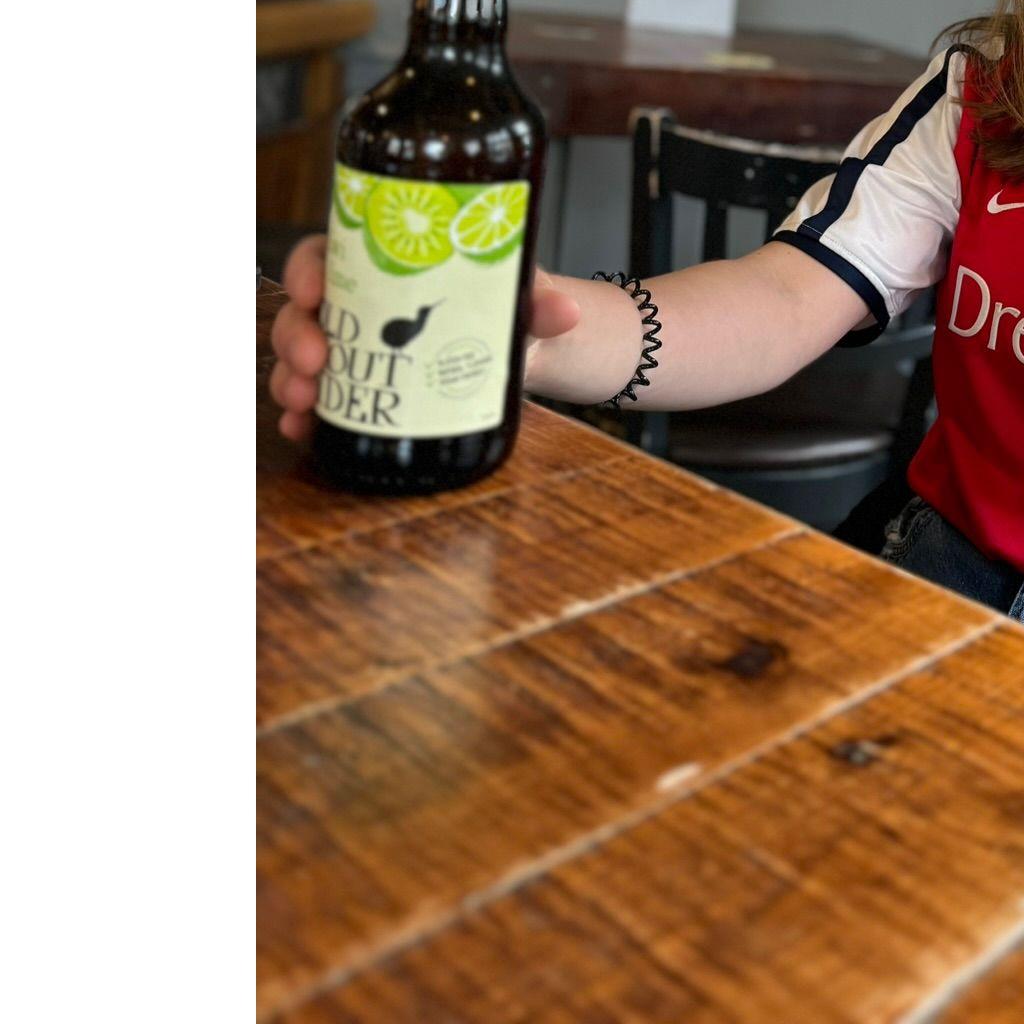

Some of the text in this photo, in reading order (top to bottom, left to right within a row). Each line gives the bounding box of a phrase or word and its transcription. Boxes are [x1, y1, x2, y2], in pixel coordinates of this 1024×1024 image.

[321, 302, 360, 343] LD
[326, 344, 413, 388] OUT
[322, 375, 401, 427] DER
